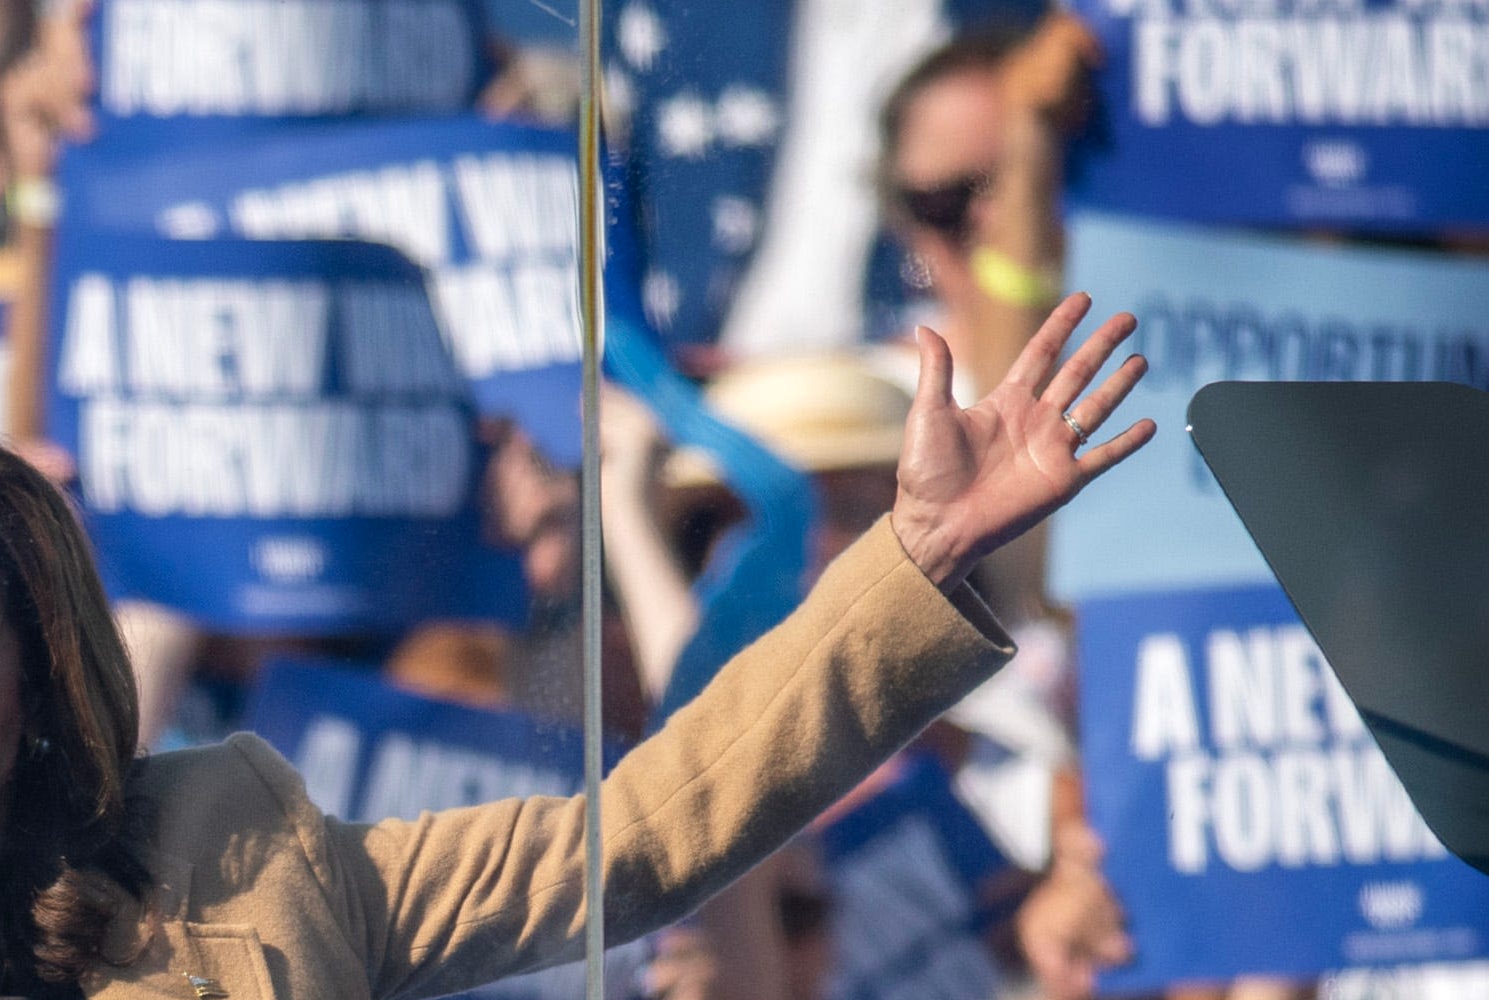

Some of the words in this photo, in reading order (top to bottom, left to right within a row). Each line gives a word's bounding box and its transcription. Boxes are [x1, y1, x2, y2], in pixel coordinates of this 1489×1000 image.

[101, 0, 473, 117] FORWARD
[57, 273, 121, 398] A
[124, 275, 329, 396] NEW
[79, 396, 469, 518] FORWARD
[1129, 628, 1203, 764] A
